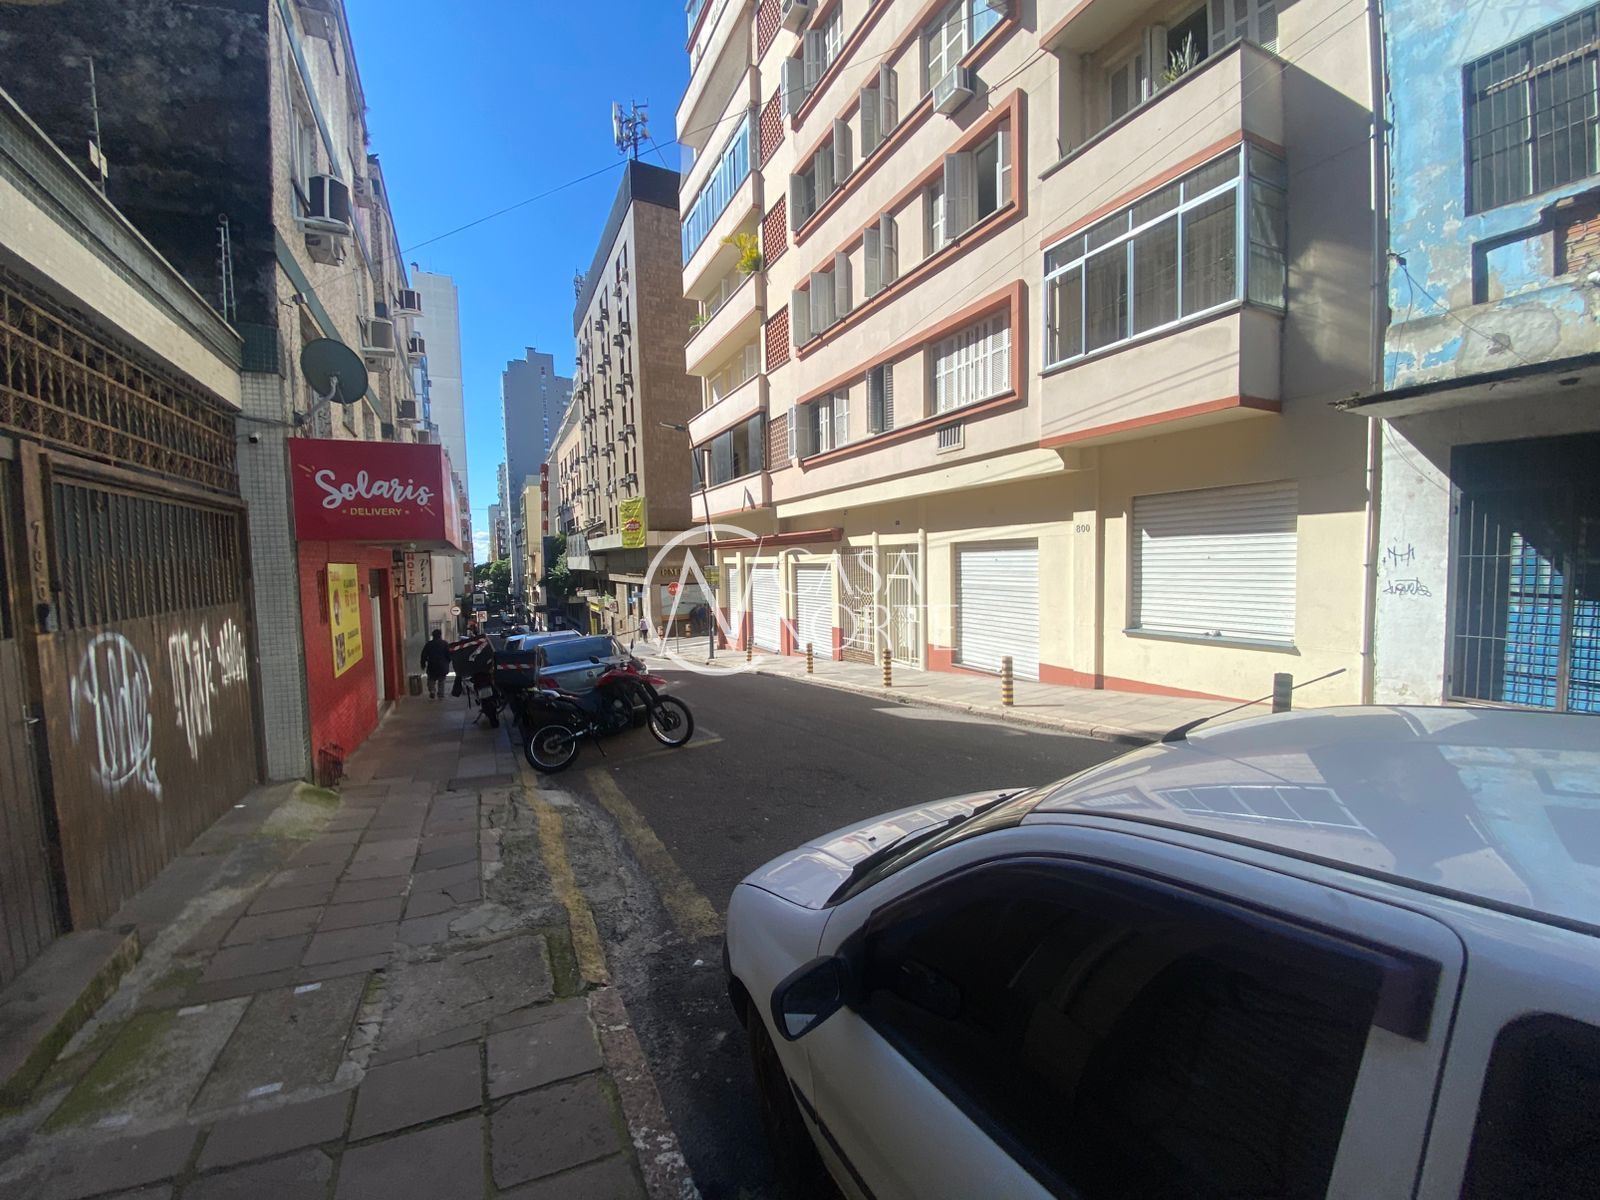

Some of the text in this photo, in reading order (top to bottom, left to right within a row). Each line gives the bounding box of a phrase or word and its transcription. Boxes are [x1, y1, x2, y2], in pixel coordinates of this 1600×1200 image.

[314, 469, 434, 509] Solaris
[350, 507, 402, 516] DELIVERY
[1075, 524, 1091, 533] 800
[406, 553, 415, 592] HOTEL
